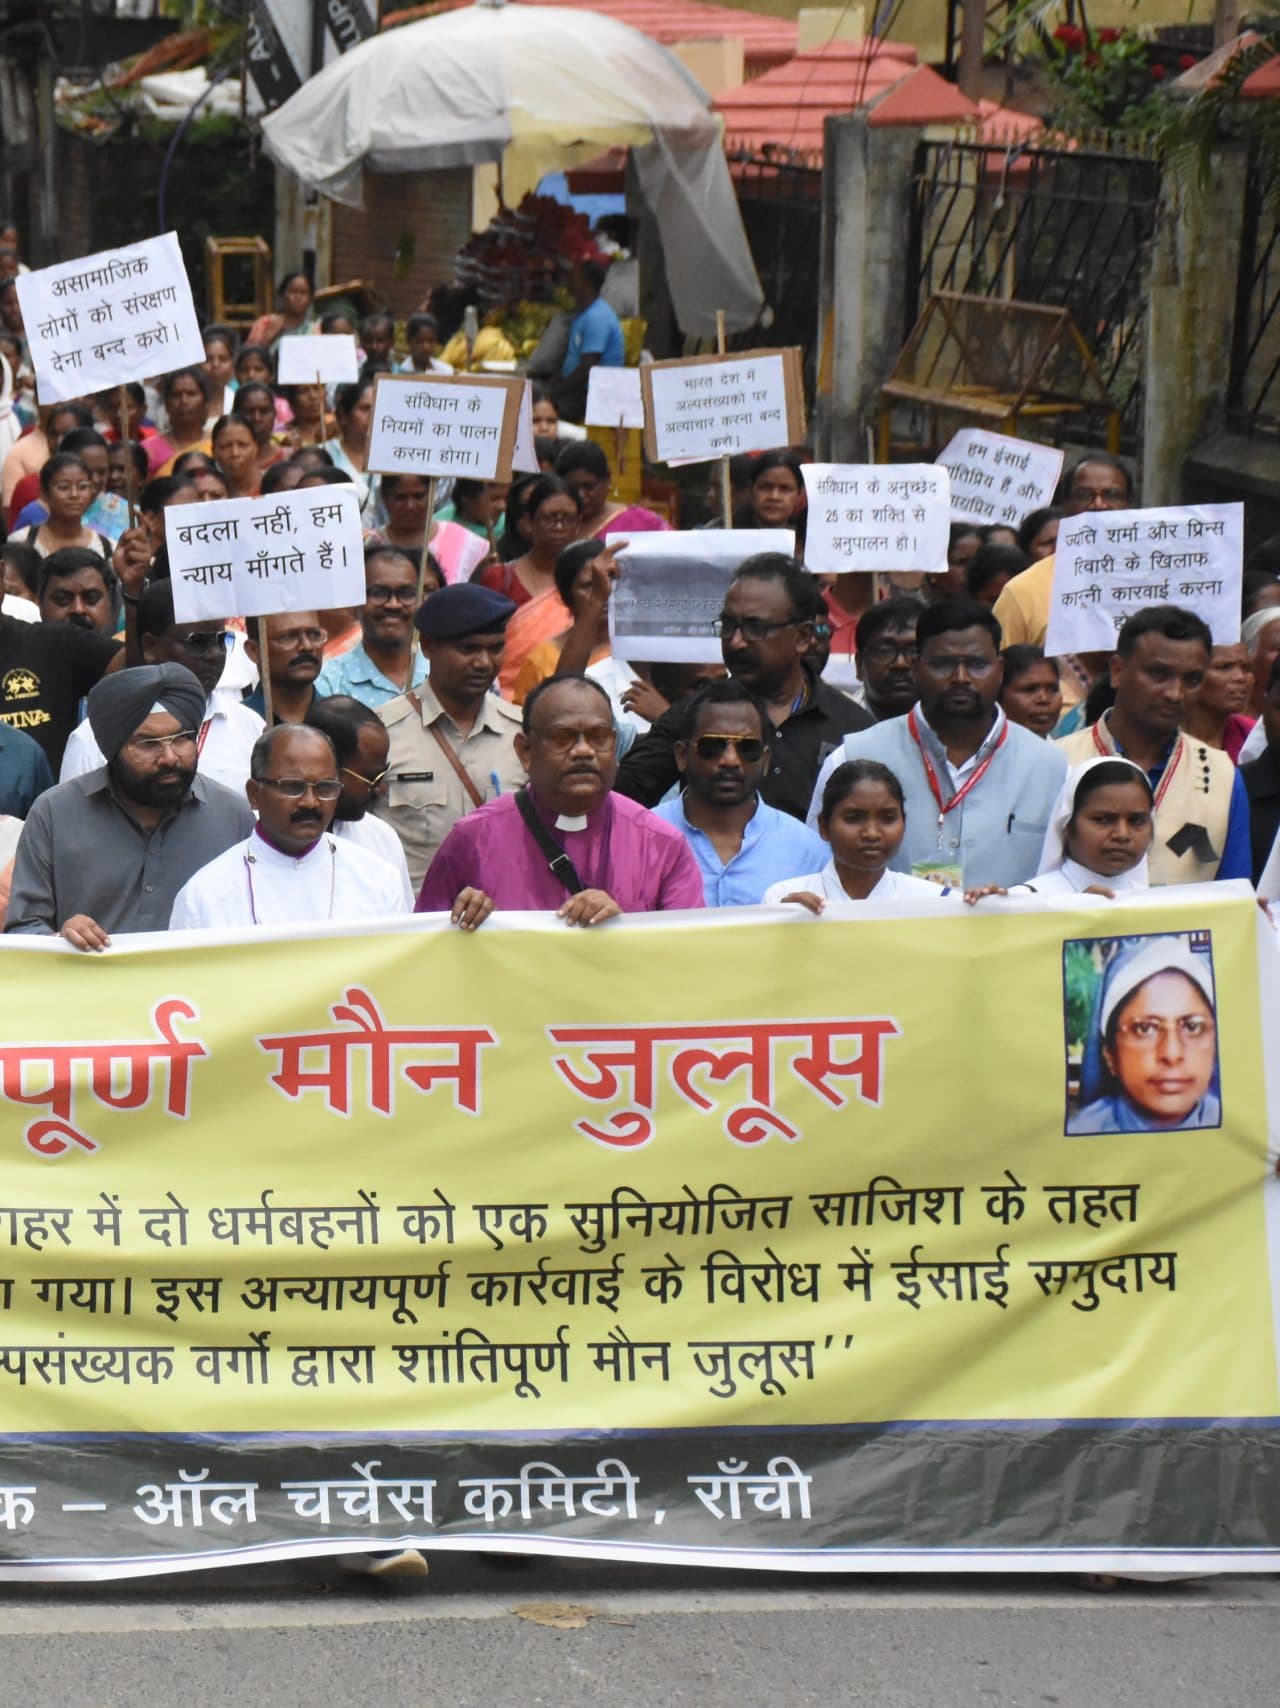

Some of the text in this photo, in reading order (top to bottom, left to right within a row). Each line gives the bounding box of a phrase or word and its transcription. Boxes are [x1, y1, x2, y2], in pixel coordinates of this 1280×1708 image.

[52, 256, 149, 297] असामाजिक
[37, 286, 178, 340] लोगों को संरक्षण
[51, 348, 83, 374] देना
[91, 337, 127, 361] बन्द
[683, 376, 713, 390] भारत
[720, 371, 740, 385] देश
[404, 391, 483, 413] संविधान के
[752, 389, 768, 403] पर
[432, 422, 453, 438] का
[460, 424, 499, 441] पालन
[665, 416, 715, 434] अत्याचार
[721, 413, 753, 427] करना
[393, 445, 433, 462] करना
[967, 442, 989, 459] हम
[866, 476, 881, 495] के
[942, 462, 994, 489] ांतिप्रिय
[175, 503, 343, 546] बदला नहीं, हम
[825, 508, 839, 523] 25
[846, 508, 863, 523] का
[911, 503, 926, 523] से
[1106, 521, 1139, 544] शर्मा
[1148, 519, 1179, 540] और
[1187, 517, 1226, 539] प्रिन्स
[831, 536, 889, 556] अनुपालन
[180, 561, 234, 586] न्याय
[245, 545, 306, 580] माँगते
[1125, 551, 1141, 572] के
[1150, 550, 1210, 571] खिलाफ
[1179, 579, 1223, 597] करना
[258, 986, 496, 1115] मौन
[549, 1018, 899, 1149] जुलूस
[88, 1192, 122, 1246] में
[139, 1191, 189, 1246] दो
[209, 1189, 380, 1250] धर्मबहनों
[398, 1188, 456, 1244] को
[474, 1204, 548, 1252] एक
[565, 1184, 793, 1255] सुनियोजित
[810, 1176, 964, 1226] साजिश
[981, 1170, 1026, 1225] के
[1043, 1184, 1140, 1227] तहत
[151, 1278, 223, 1322] इस
[241, 1260, 452, 1324] अन्यायपूर्ण
[468, 1252, 625, 1313] कार्रवाई
[641, 1253, 685, 1303] के
[700, 1247, 821, 1303] विरोध
[838, 1246, 874, 1301] में
[890, 1243, 1010, 1309] ईसाई
[1028, 1252, 1177, 1311] समुदाय
[288, 1345, 376, 1386] द्वारा
[397, 1322, 570, 1398] शांतिपूर्ण
[587, 1325, 671, 1381] मौन
[128, 1469, 258, 1531] ऑल
[279, 1461, 436, 1526] चर्चेस
[688, 1457, 812, 1520] राँची
